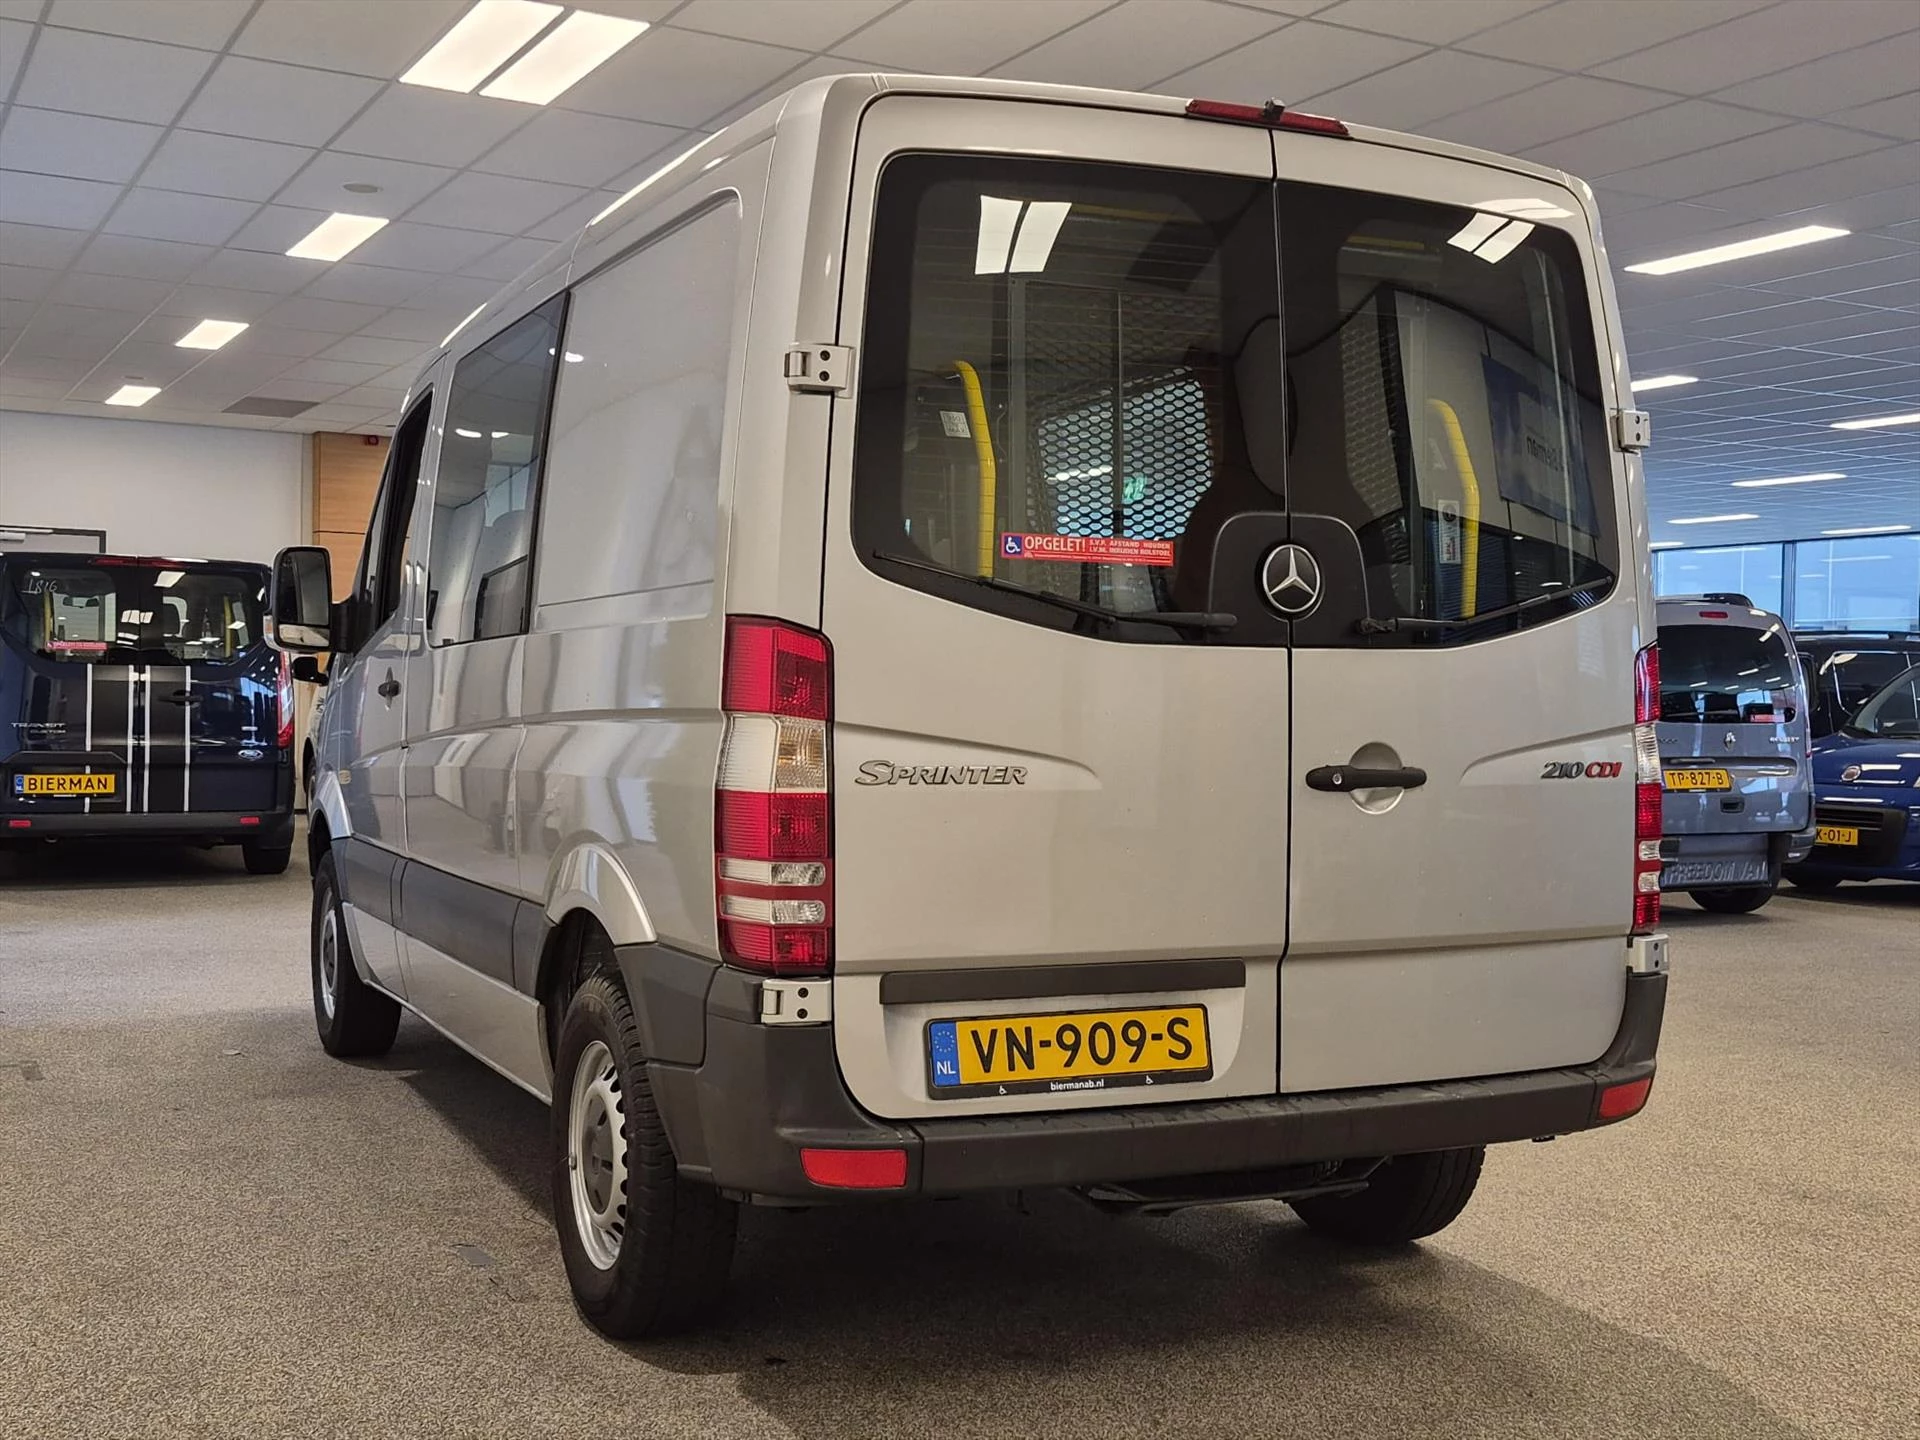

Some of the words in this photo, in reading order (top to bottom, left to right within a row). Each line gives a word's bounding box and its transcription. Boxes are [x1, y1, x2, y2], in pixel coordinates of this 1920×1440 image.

[1024, 535, 1086, 553] OPGELET!
[1109, 540, 1140, 548] AFSTAND
[1143, 541, 1171, 549] HOUDEN
[1540, 762, 1585, 779] 210
[1585, 762, 1622, 778] CDI
[28, 777, 108, 791] BIERMAN
[1669, 772, 1724, 786] TP-827-B
[971, 1017, 1193, 1074] VN-909-S
[936, 1060, 957, 1075] NL
[1050, 1078, 1105, 1091] biermanab.nl
